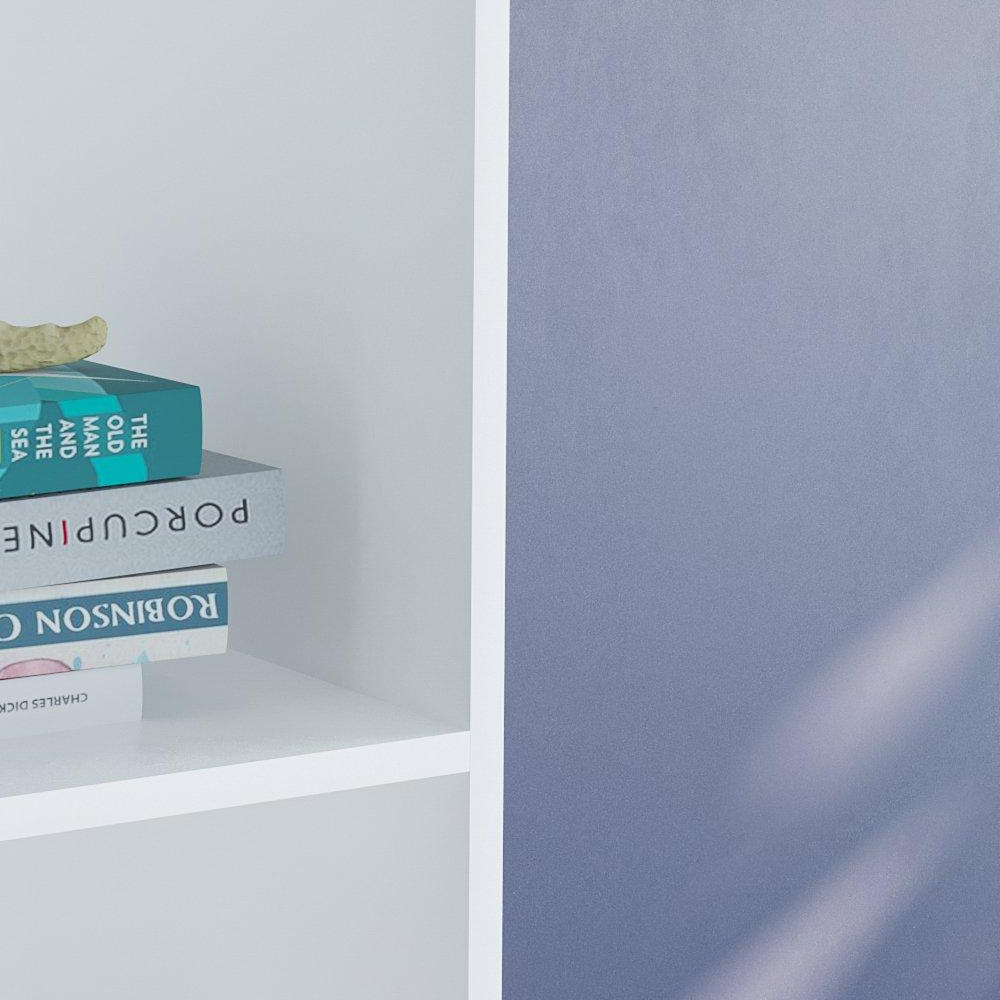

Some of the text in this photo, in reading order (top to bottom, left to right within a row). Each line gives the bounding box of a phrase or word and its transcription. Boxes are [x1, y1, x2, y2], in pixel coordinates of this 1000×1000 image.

[10, 427, 29, 463] SEA
[35, 423, 53, 460] THE
[59, 418, 77, 459] AND
[83, 416, 101, 457] MAN
[107, 414, 125, 453] OLD
[131, 413, 148, 449] THE
[3, 498, 249, 553] PORCUPINE
[36, 592, 219, 636] ROBINSON
[32, 692, 88, 709] CHARLES
